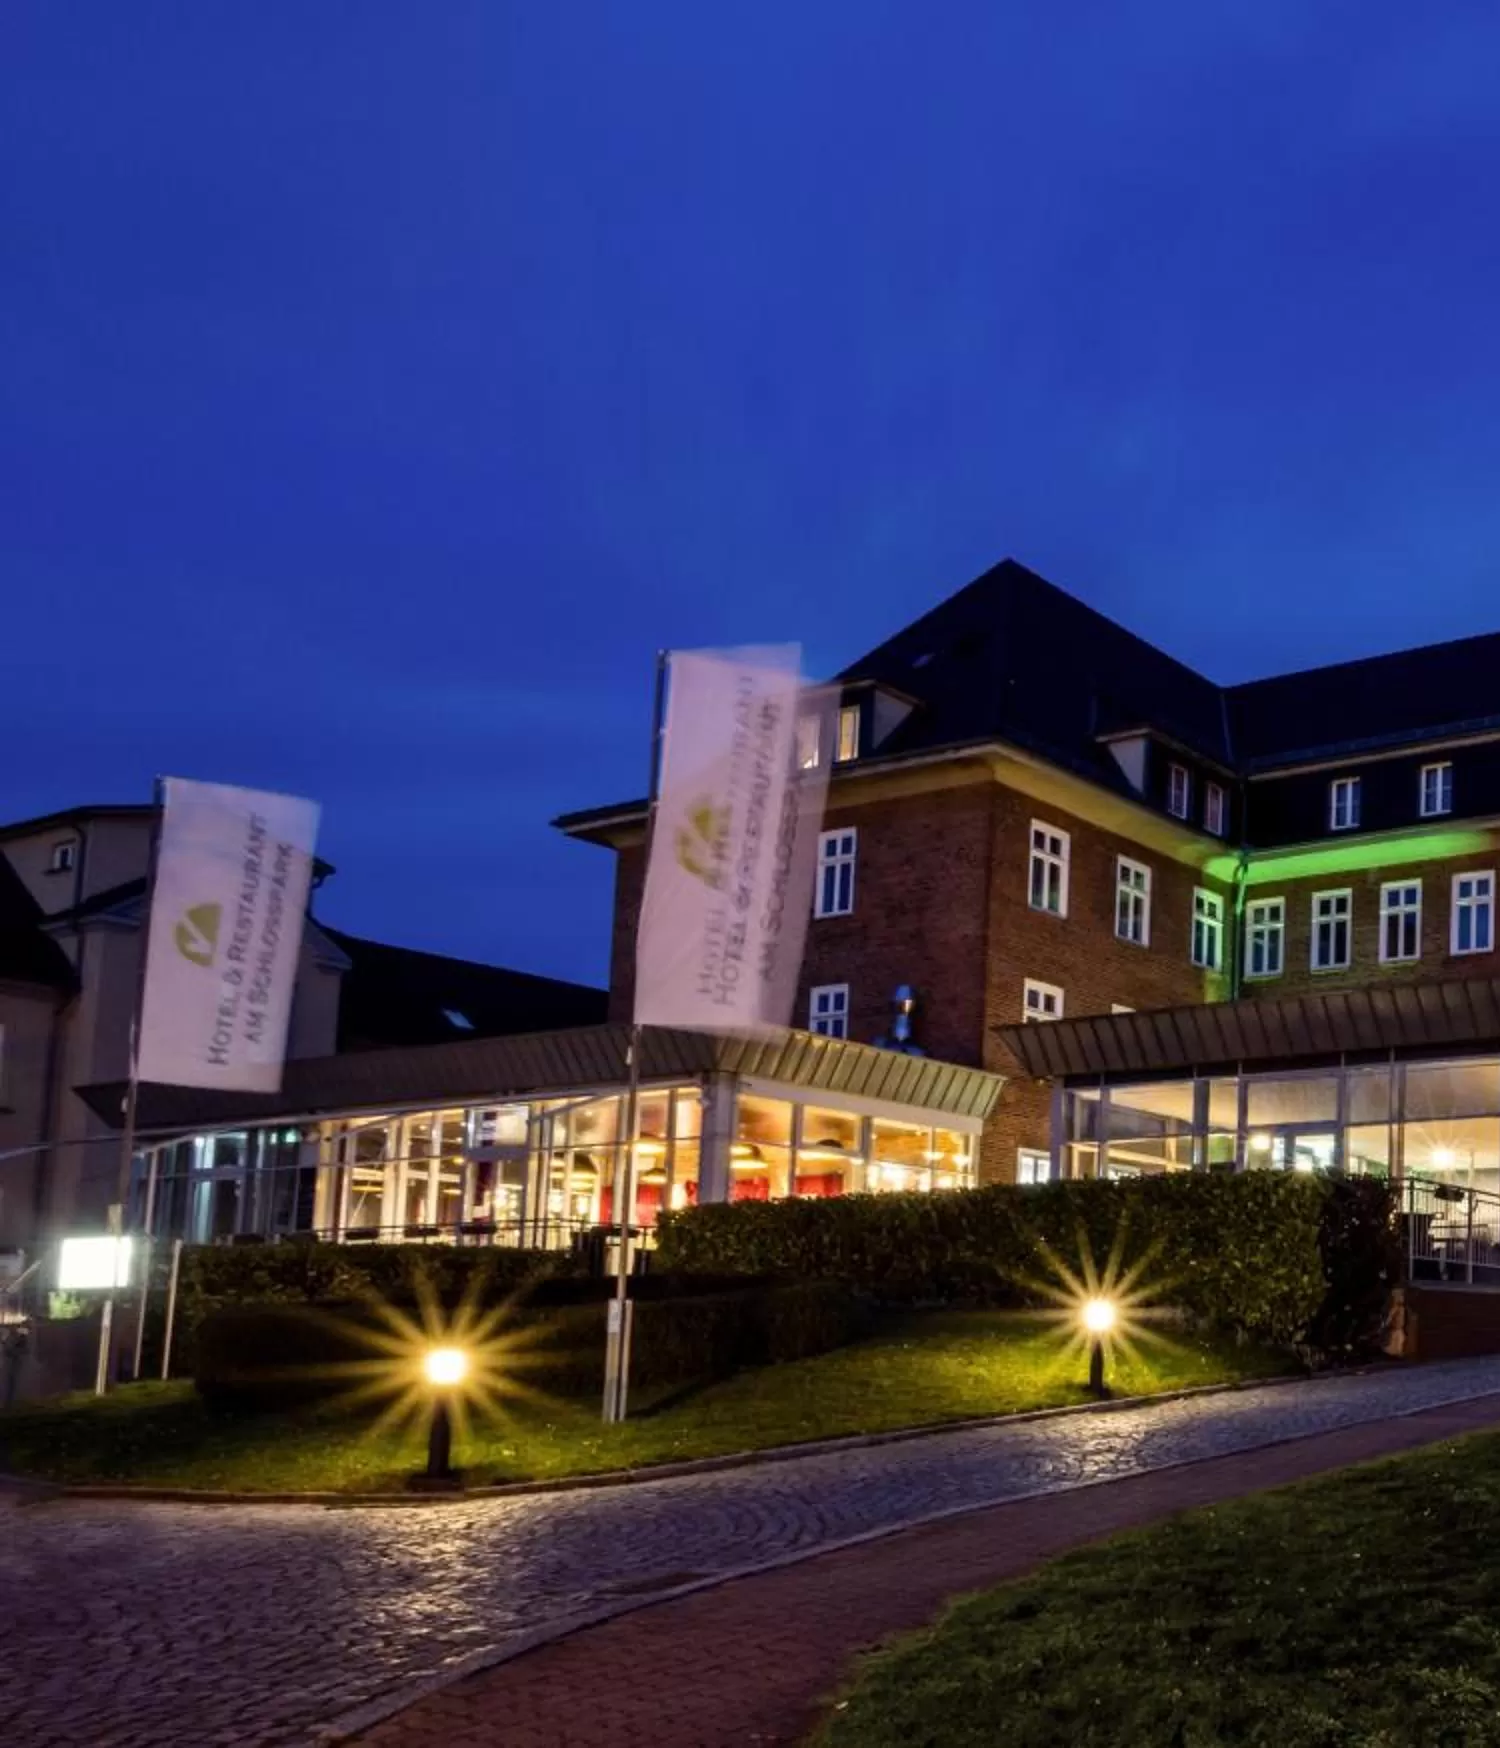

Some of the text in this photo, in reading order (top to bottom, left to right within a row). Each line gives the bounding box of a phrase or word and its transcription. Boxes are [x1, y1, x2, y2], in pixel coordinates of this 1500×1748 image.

[207, 812, 267, 1065] HOTEL & RESTAURANT
[244, 843, 294, 1044] AM SCHLOSSPARK
